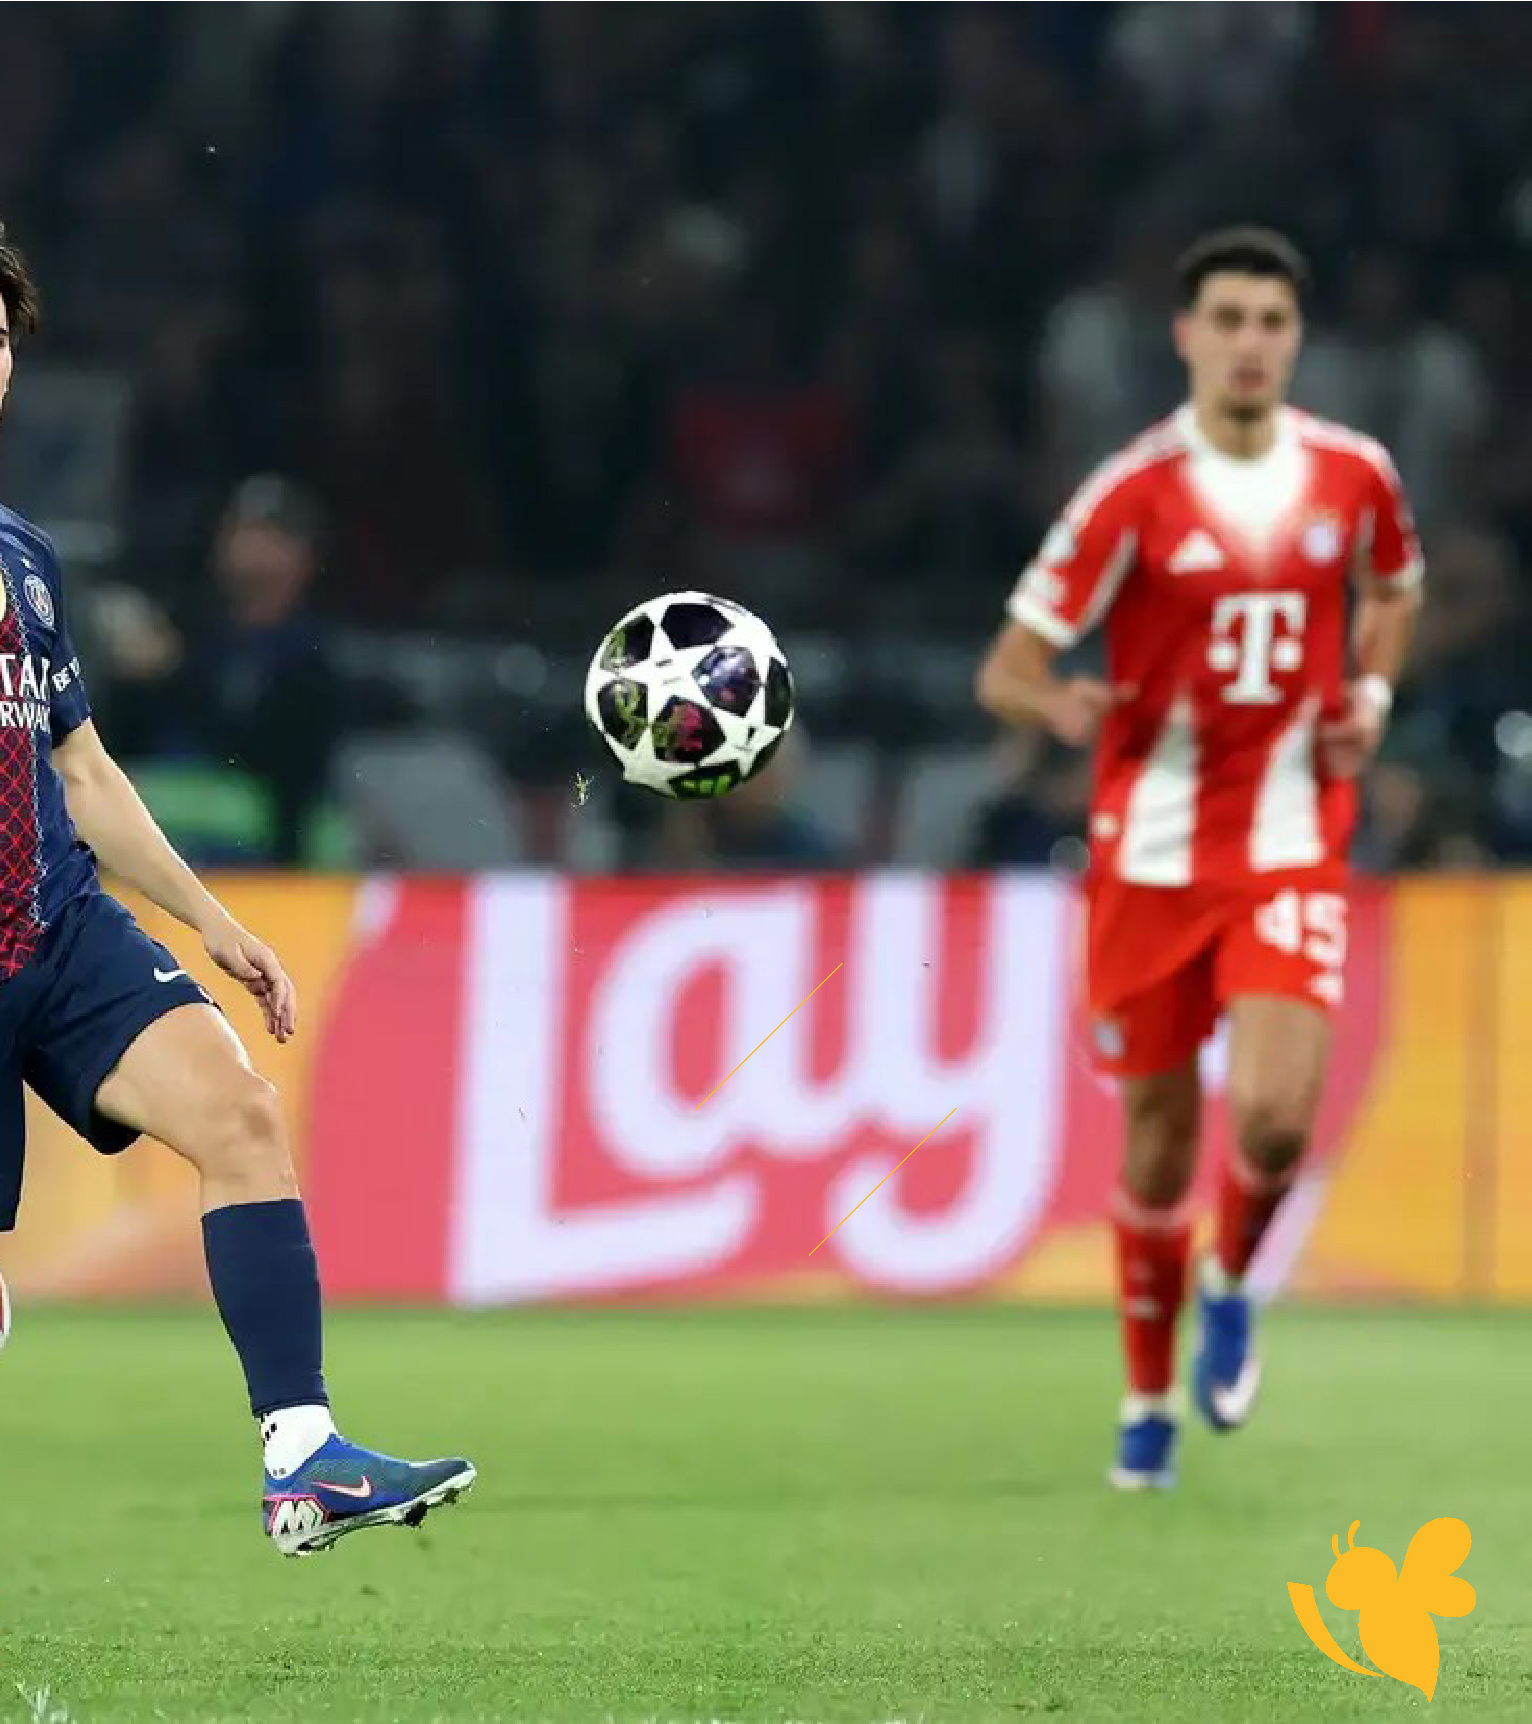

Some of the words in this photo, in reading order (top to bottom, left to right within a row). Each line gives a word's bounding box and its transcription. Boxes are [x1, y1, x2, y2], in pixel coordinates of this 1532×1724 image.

[1208, 592, 1307, 705] T
[1255, 889, 1348, 966] 45
[446, 874, 1108, 1308] Lay
